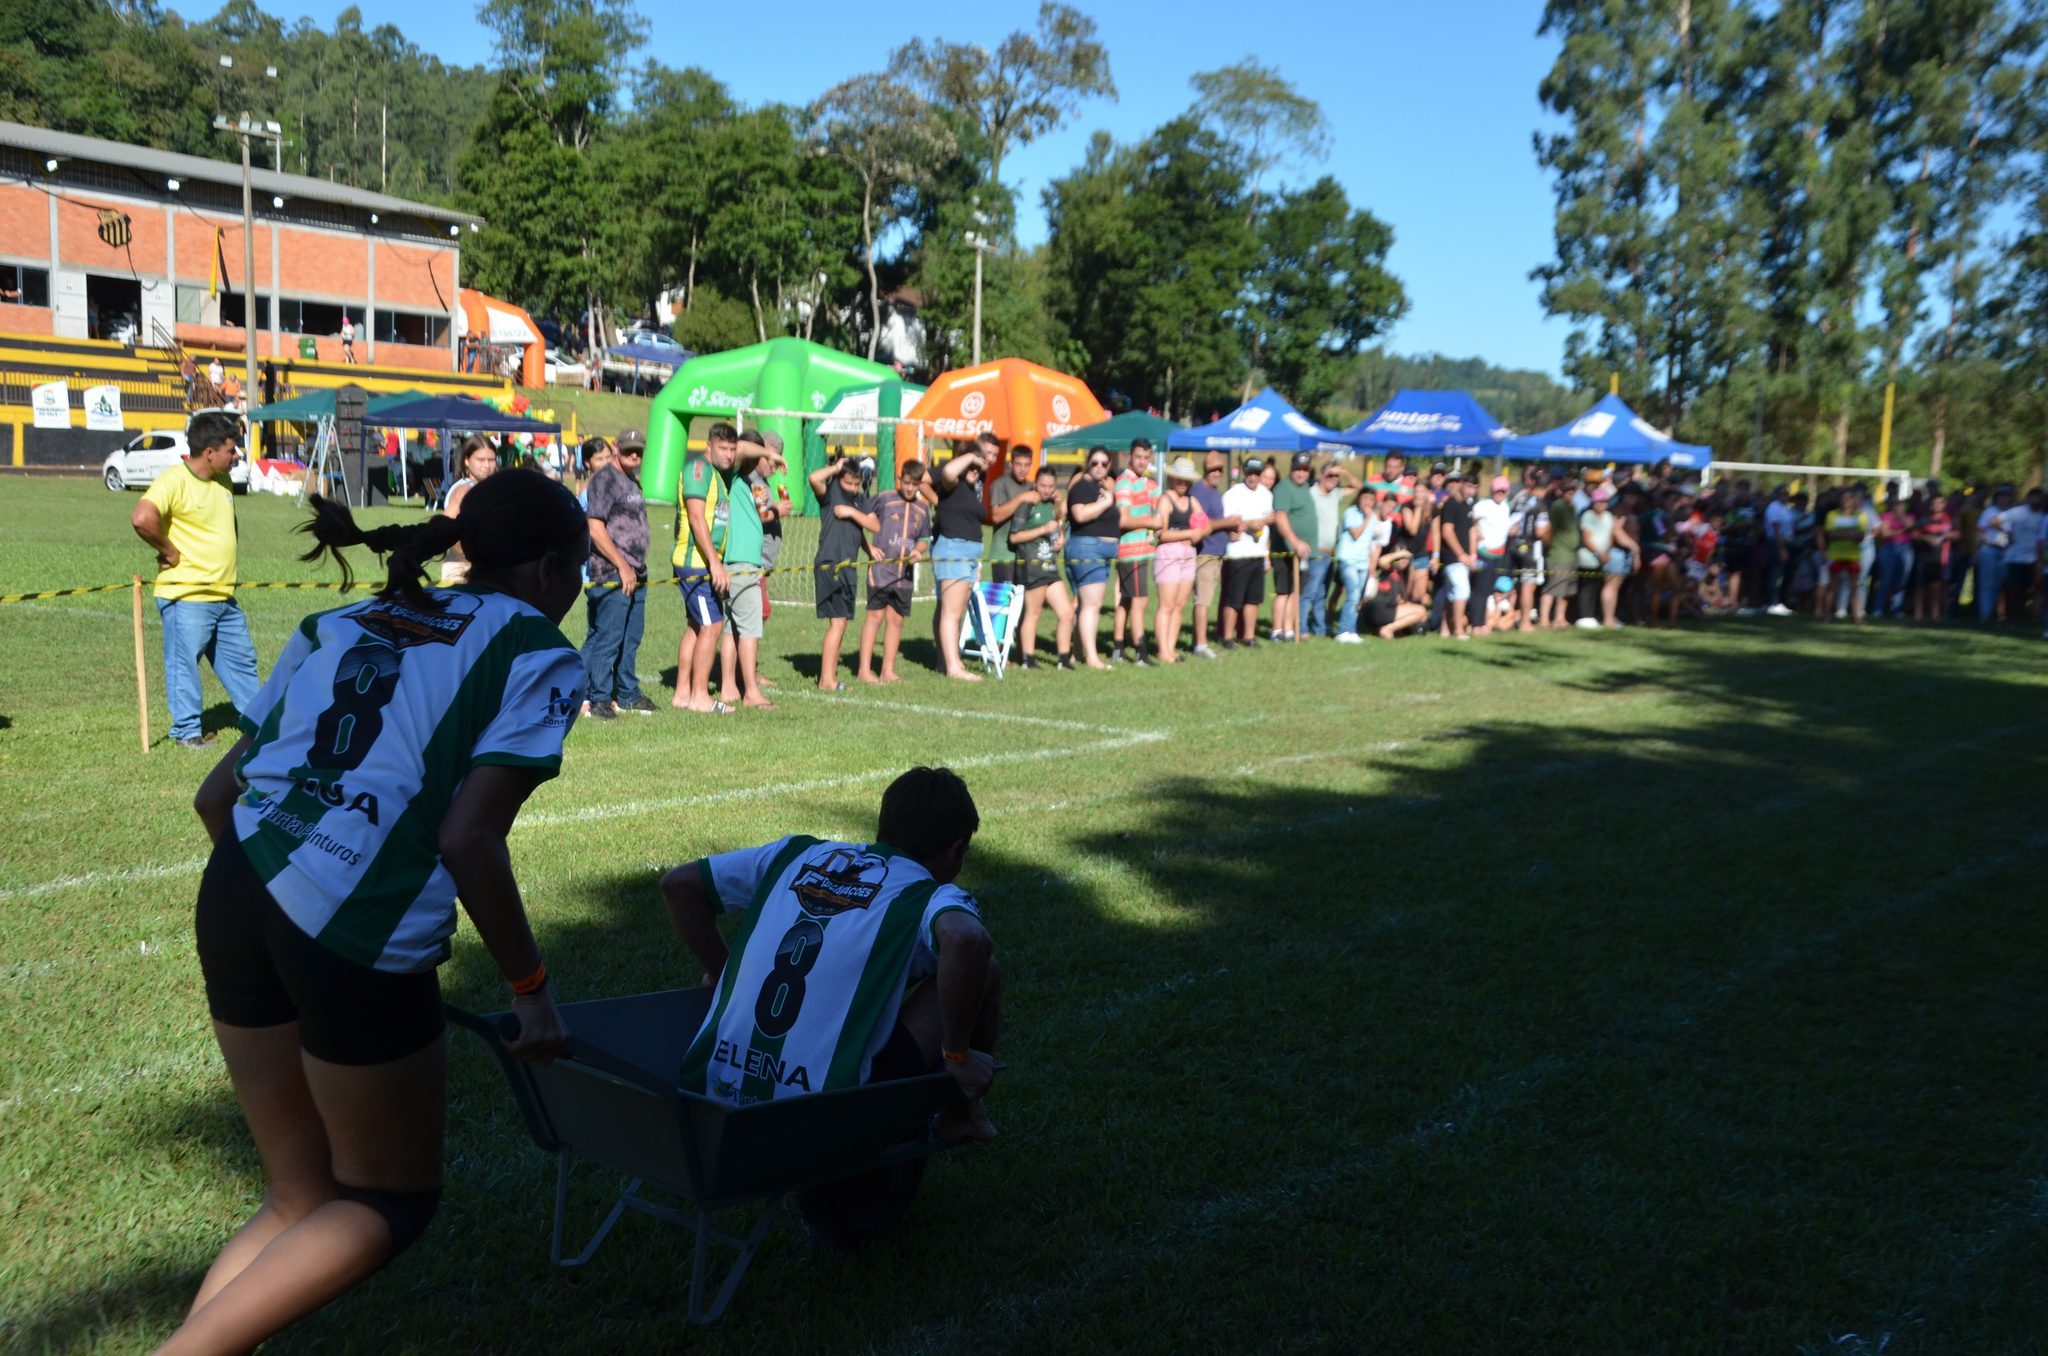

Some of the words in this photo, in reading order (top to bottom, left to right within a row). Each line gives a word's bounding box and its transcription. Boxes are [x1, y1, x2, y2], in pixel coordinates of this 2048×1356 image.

[307, 642, 400, 770] 8
[755, 919, 824, 1038] 8
[713, 1039, 811, 1092] ELENA
